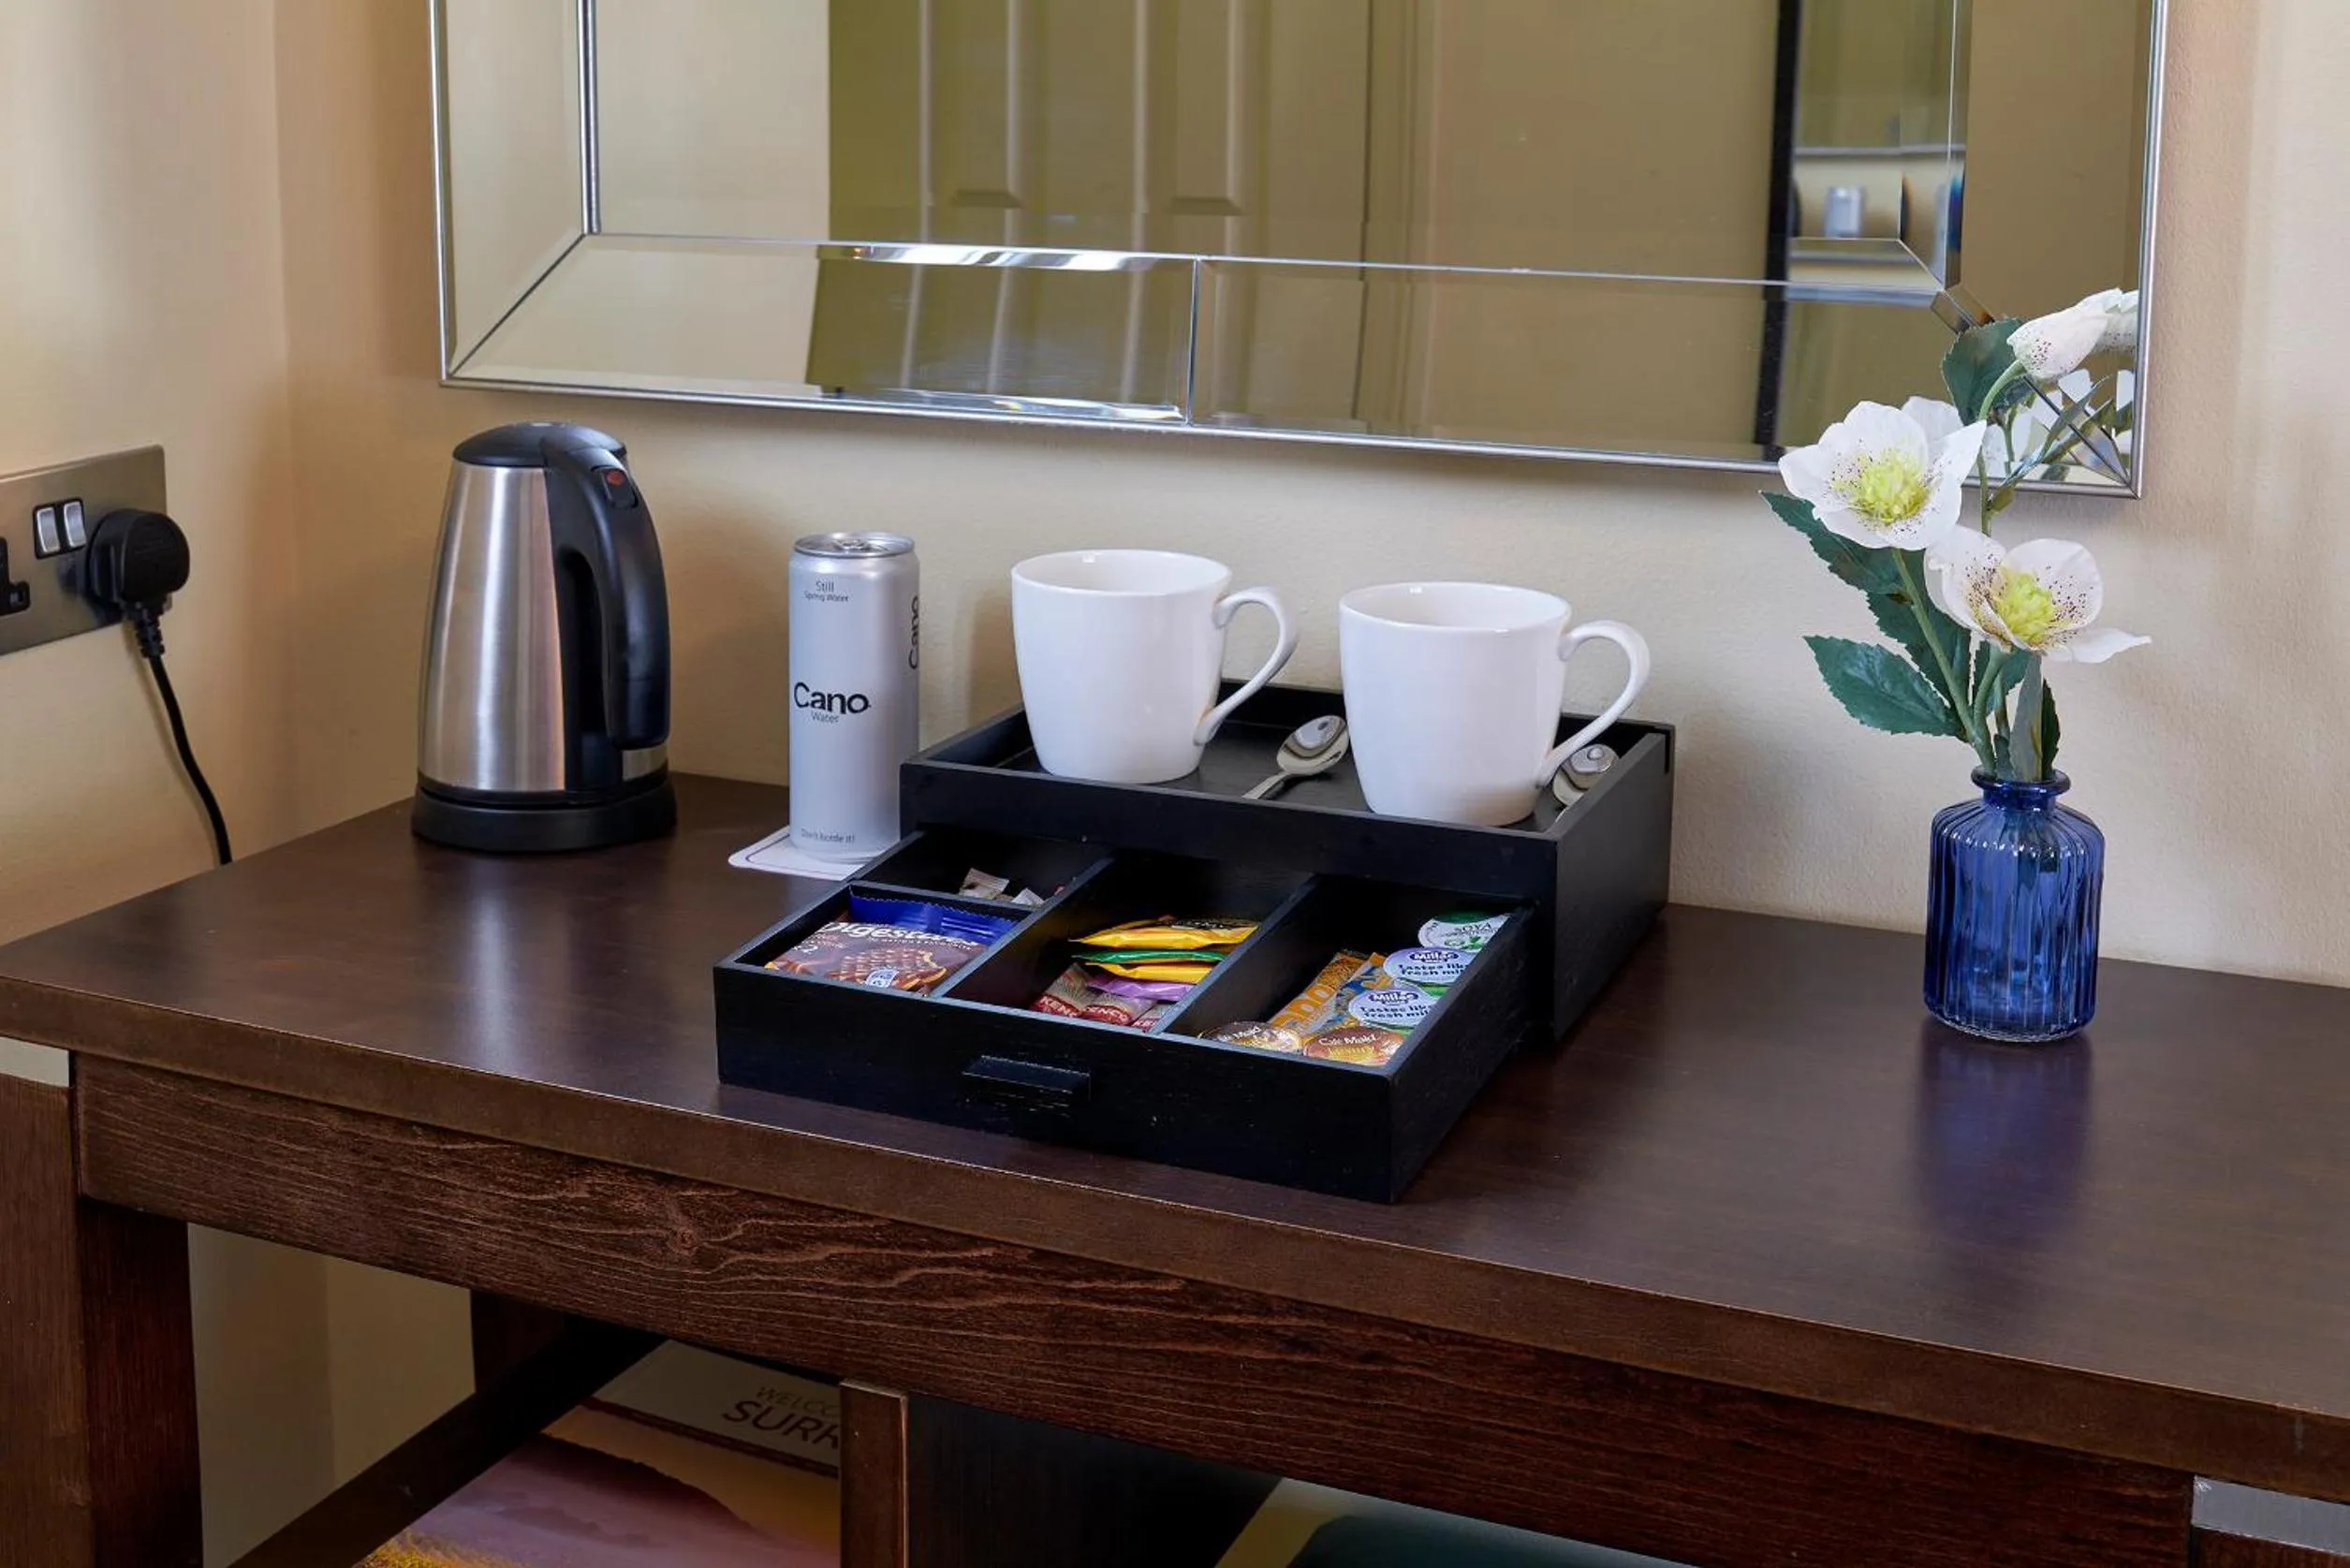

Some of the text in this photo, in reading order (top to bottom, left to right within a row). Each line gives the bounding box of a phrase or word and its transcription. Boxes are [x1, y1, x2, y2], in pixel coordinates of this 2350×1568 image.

[815, 579, 835, 592] Still
[826, 593, 849, 603] Water
[908, 596, 919, 669] Cano
[794, 681, 870, 715] Cano
[811, 711, 840, 723] Water
